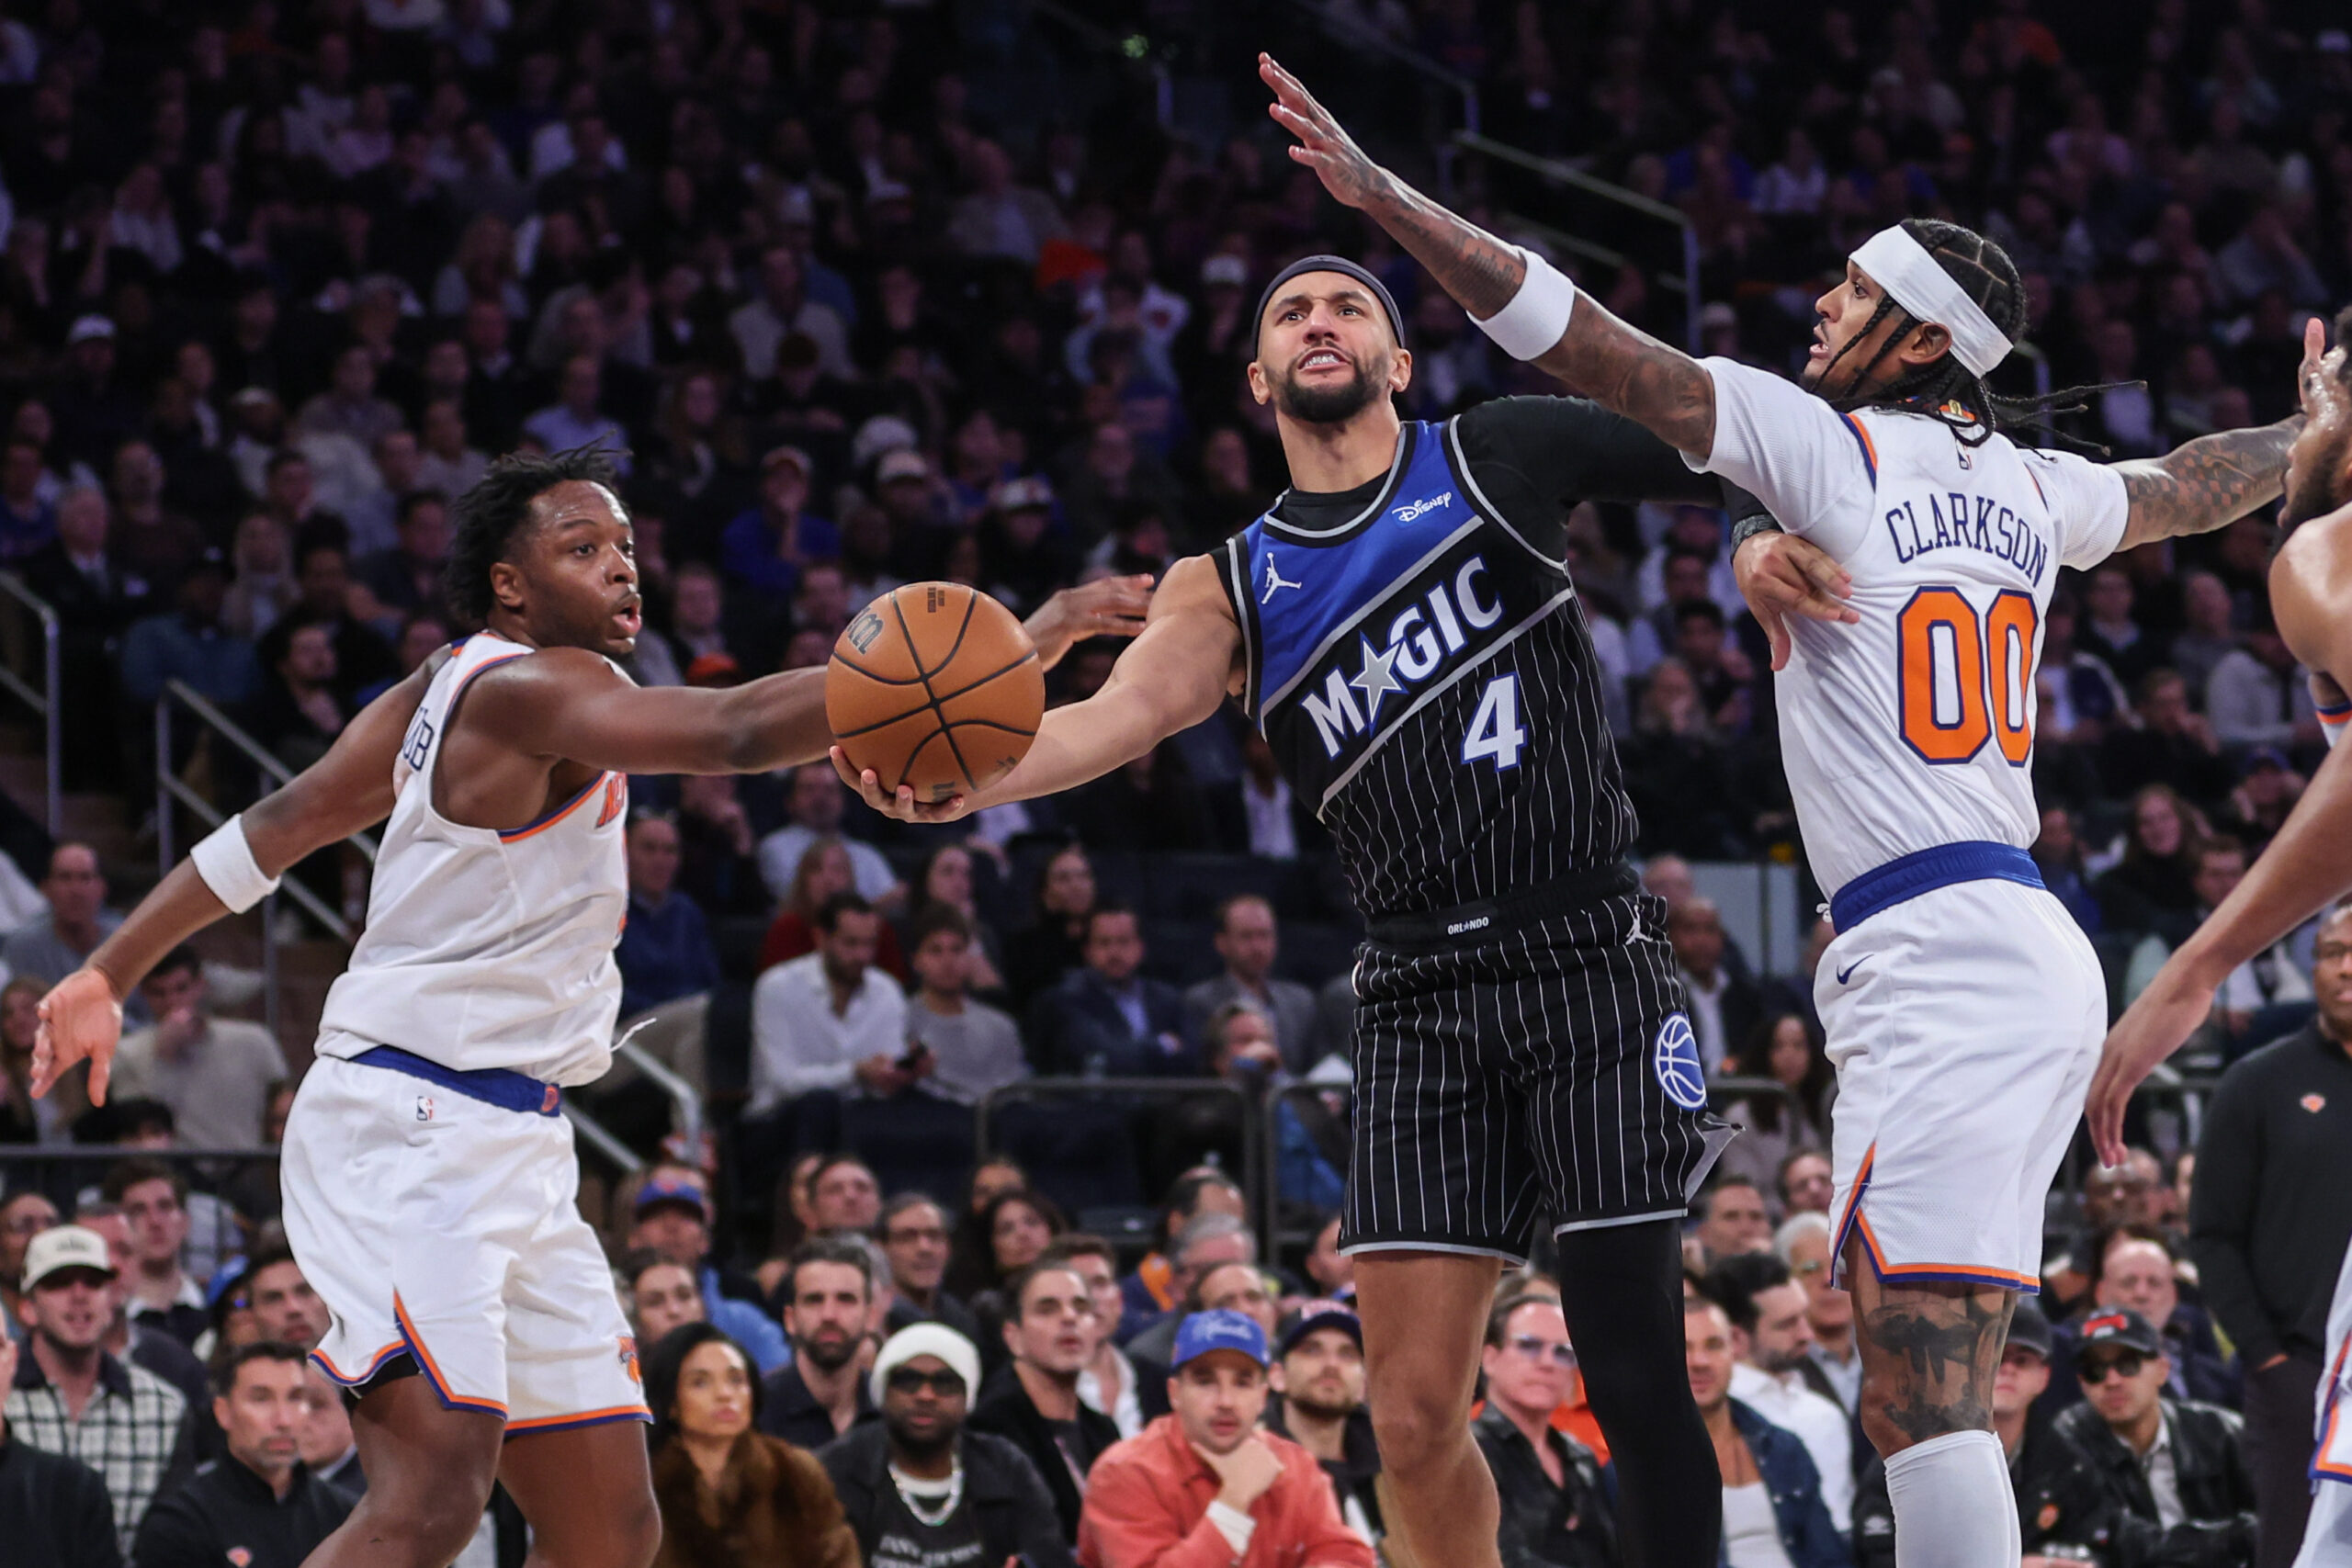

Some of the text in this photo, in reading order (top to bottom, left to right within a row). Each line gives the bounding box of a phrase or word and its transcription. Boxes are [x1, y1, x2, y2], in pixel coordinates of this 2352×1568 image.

[1391, 491, 1452, 522] Disney
[1885, 492, 2048, 588] CLARKSON
[1459, 671, 1527, 773] 4
[1896, 585, 2039, 767] 00
